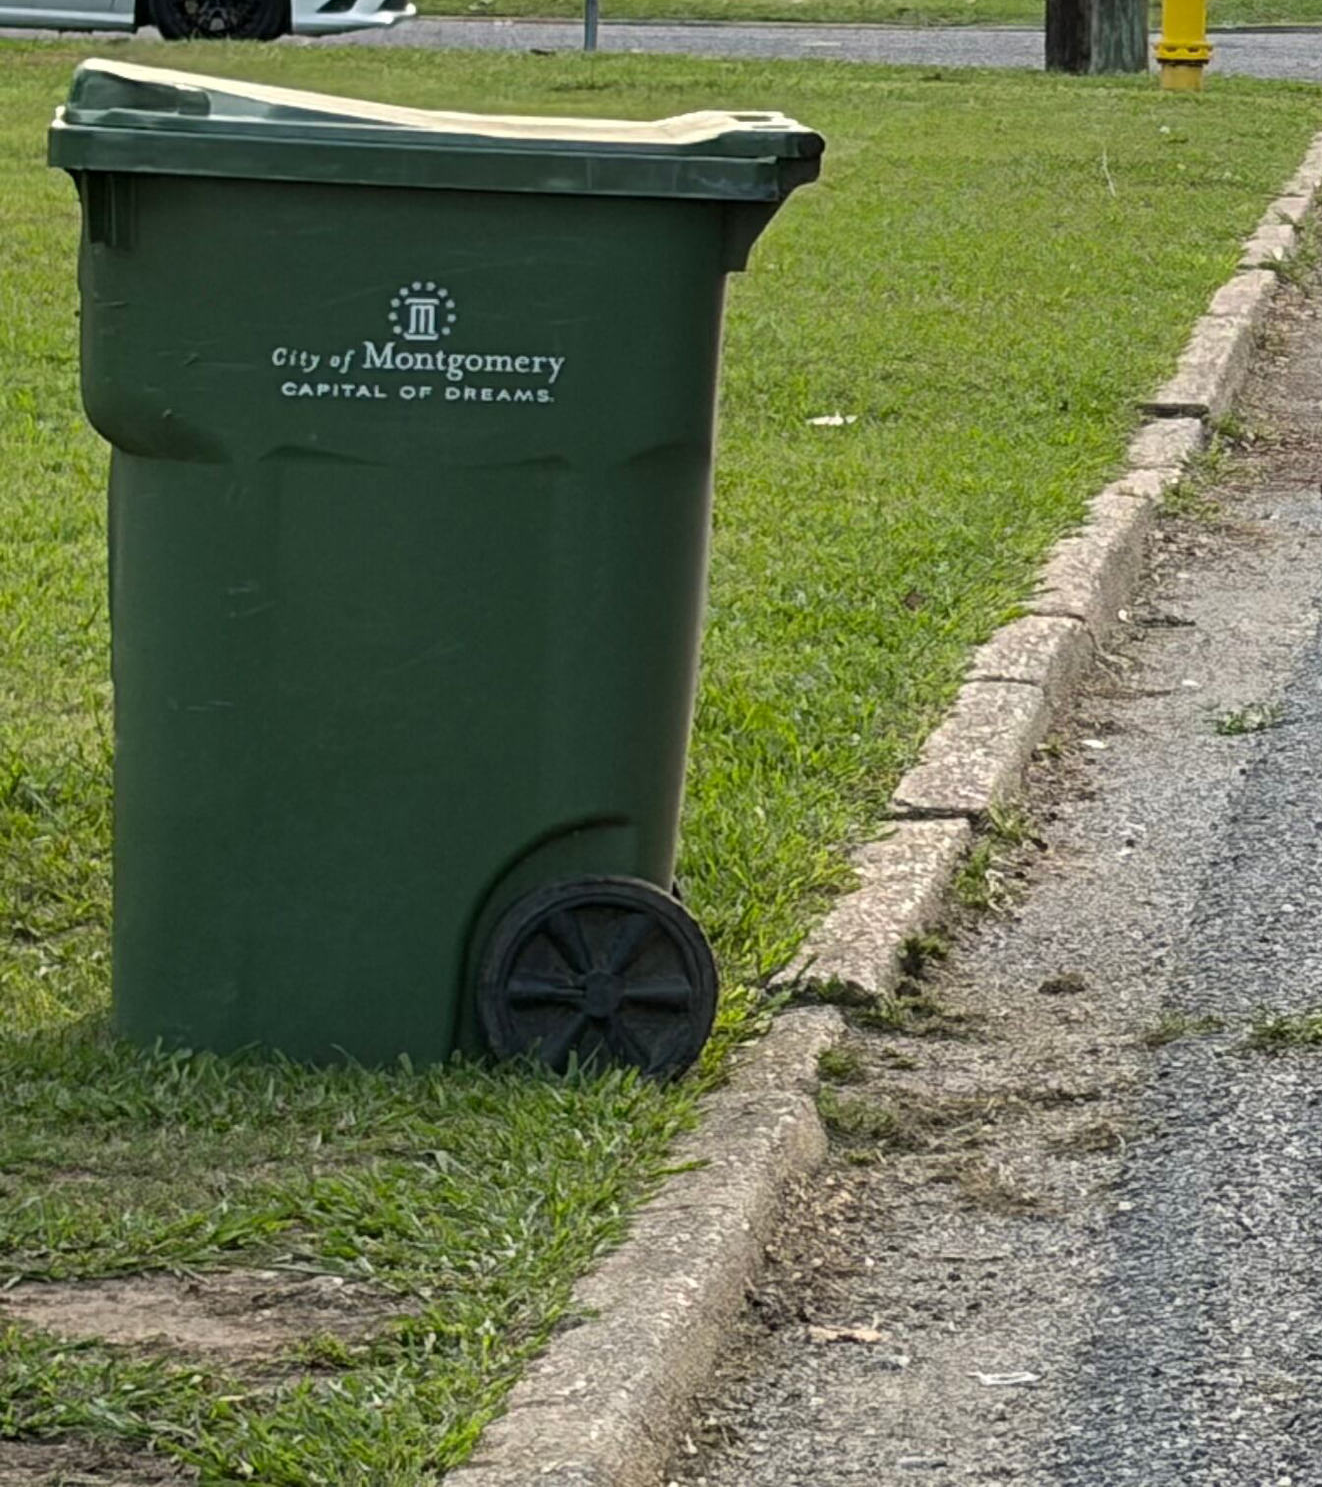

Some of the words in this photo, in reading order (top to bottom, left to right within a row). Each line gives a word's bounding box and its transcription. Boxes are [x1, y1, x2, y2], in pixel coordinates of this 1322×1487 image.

[272, 346, 321, 372] City
[330, 349, 356, 373] of
[362, 341, 566, 383] Montgomery
[281, 382, 388, 398] CAPITAL
[399, 385, 432, 399] OF
